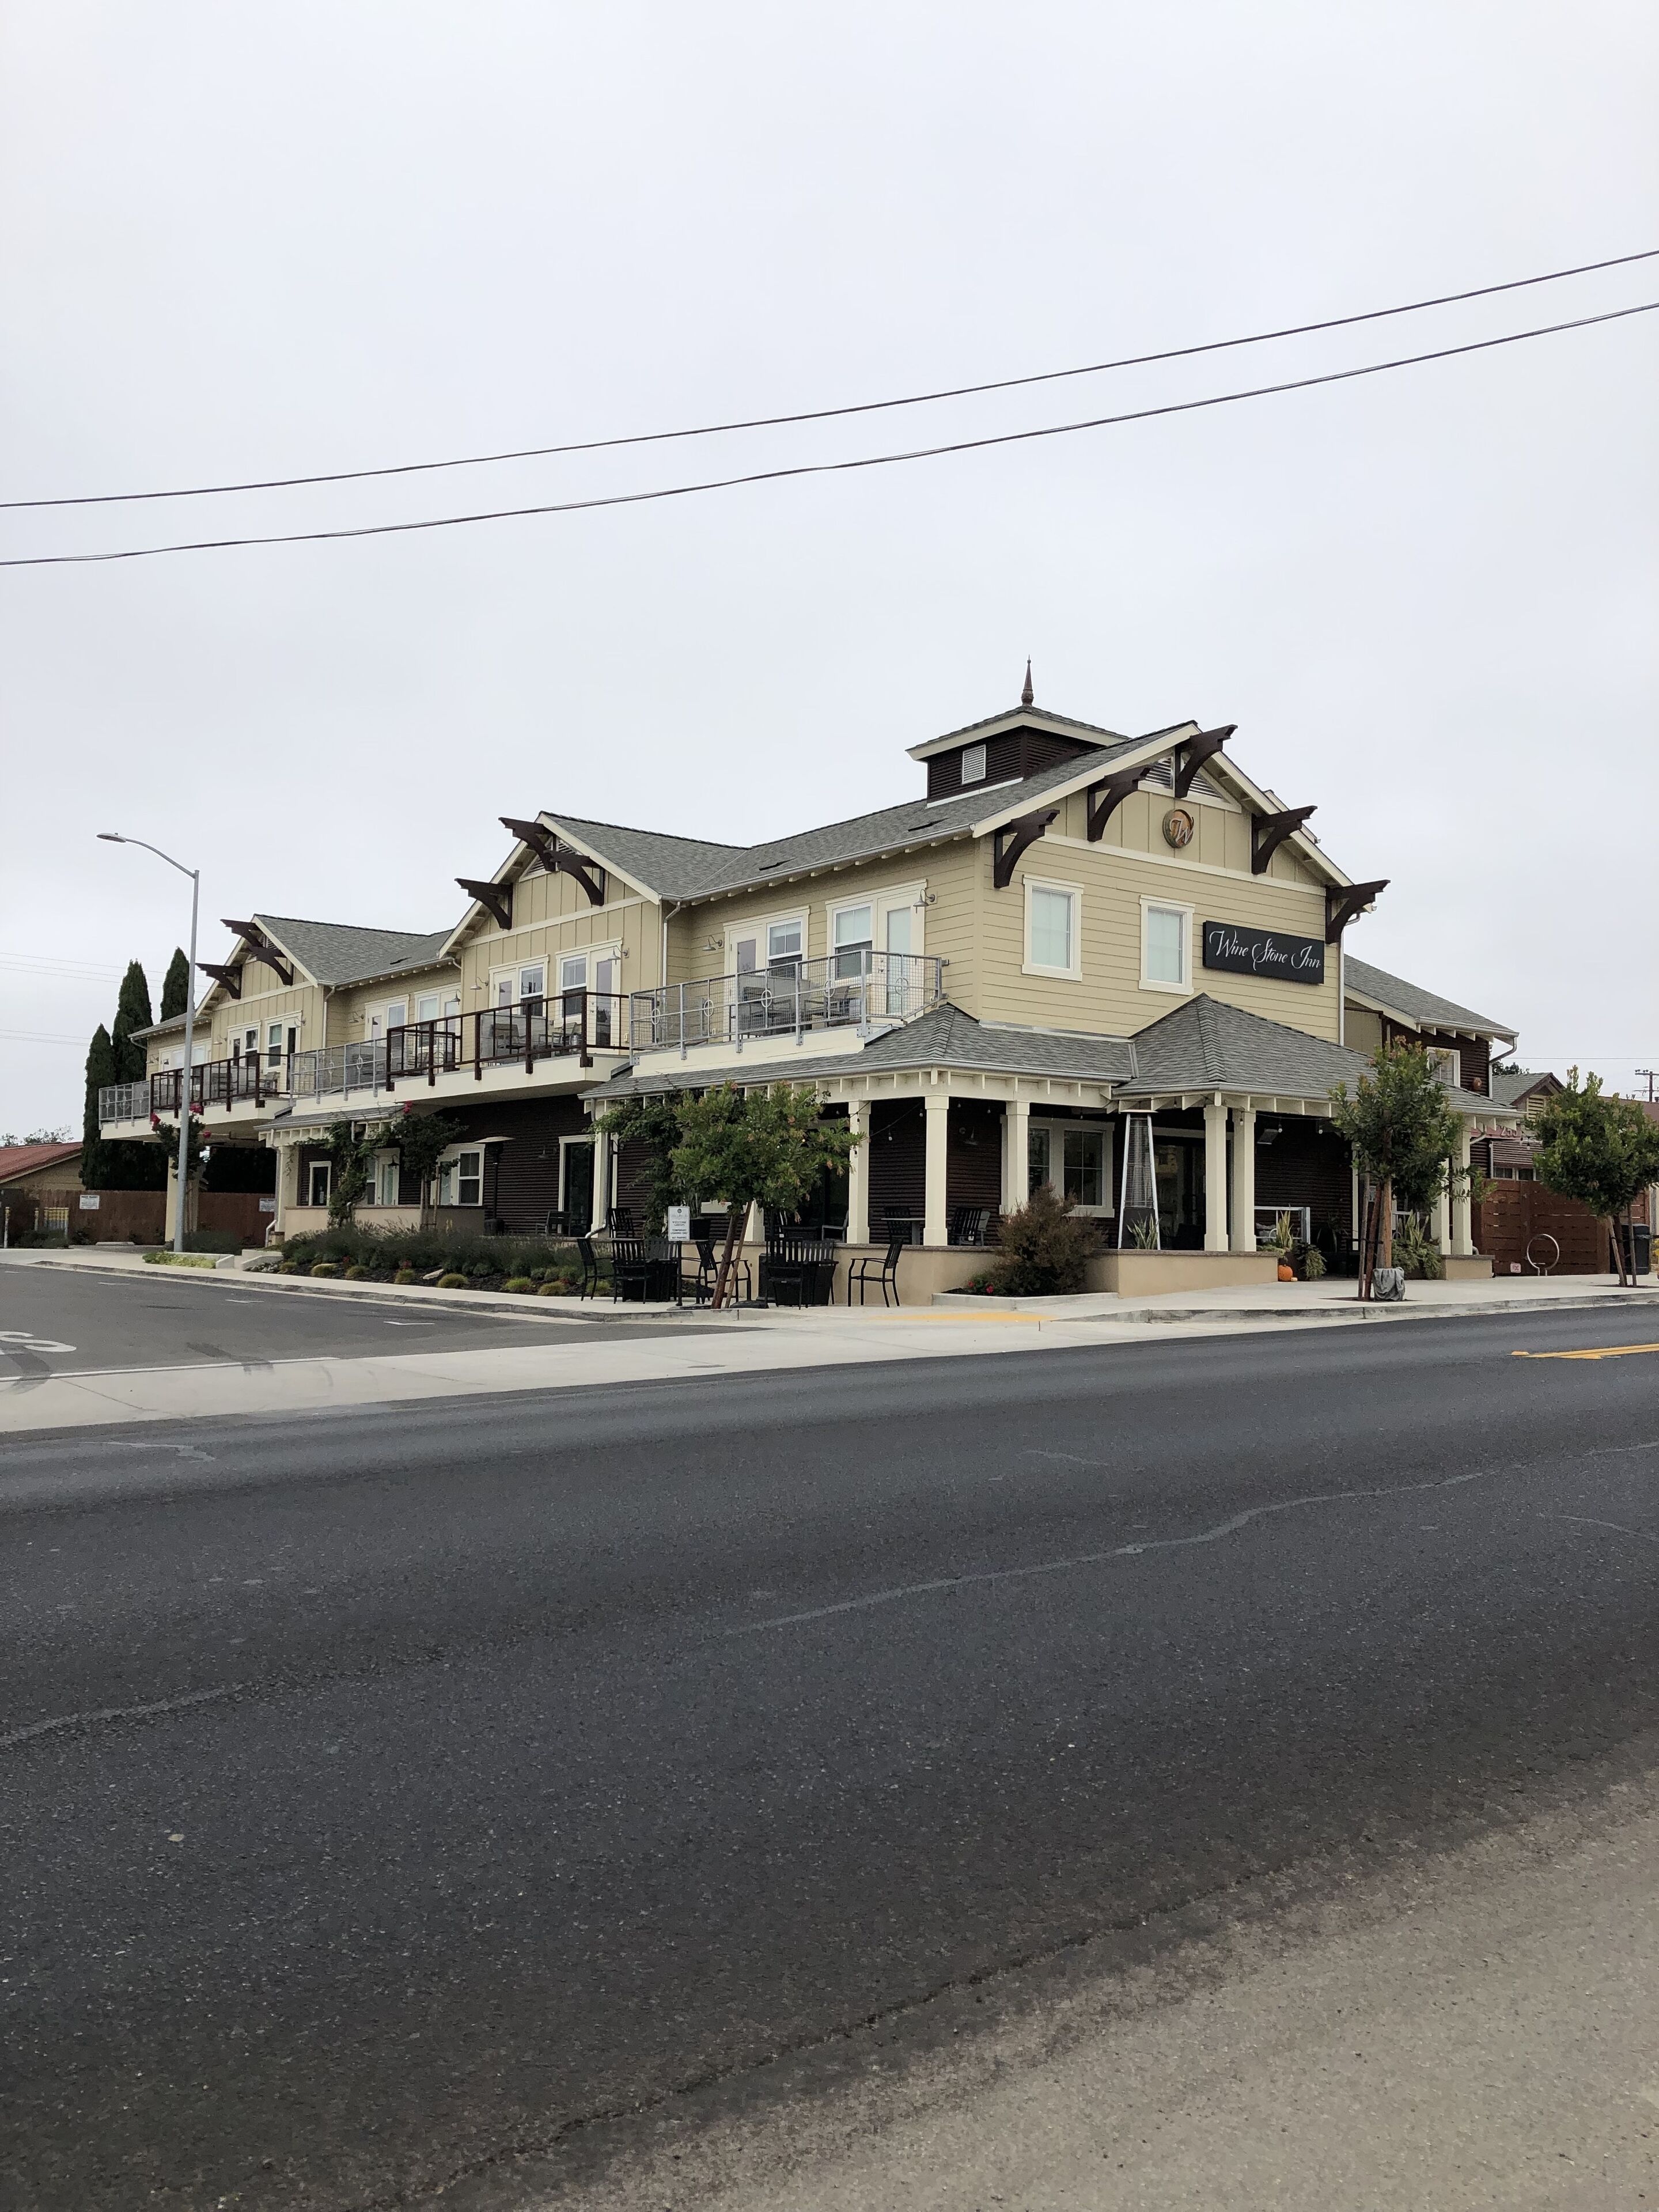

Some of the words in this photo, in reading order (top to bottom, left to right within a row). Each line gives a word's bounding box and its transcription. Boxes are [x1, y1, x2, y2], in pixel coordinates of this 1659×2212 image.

[1209, 929, 1248, 957] Wine
[1252, 938, 1288, 971] Stone
[1291, 945, 1321, 969] Inn
